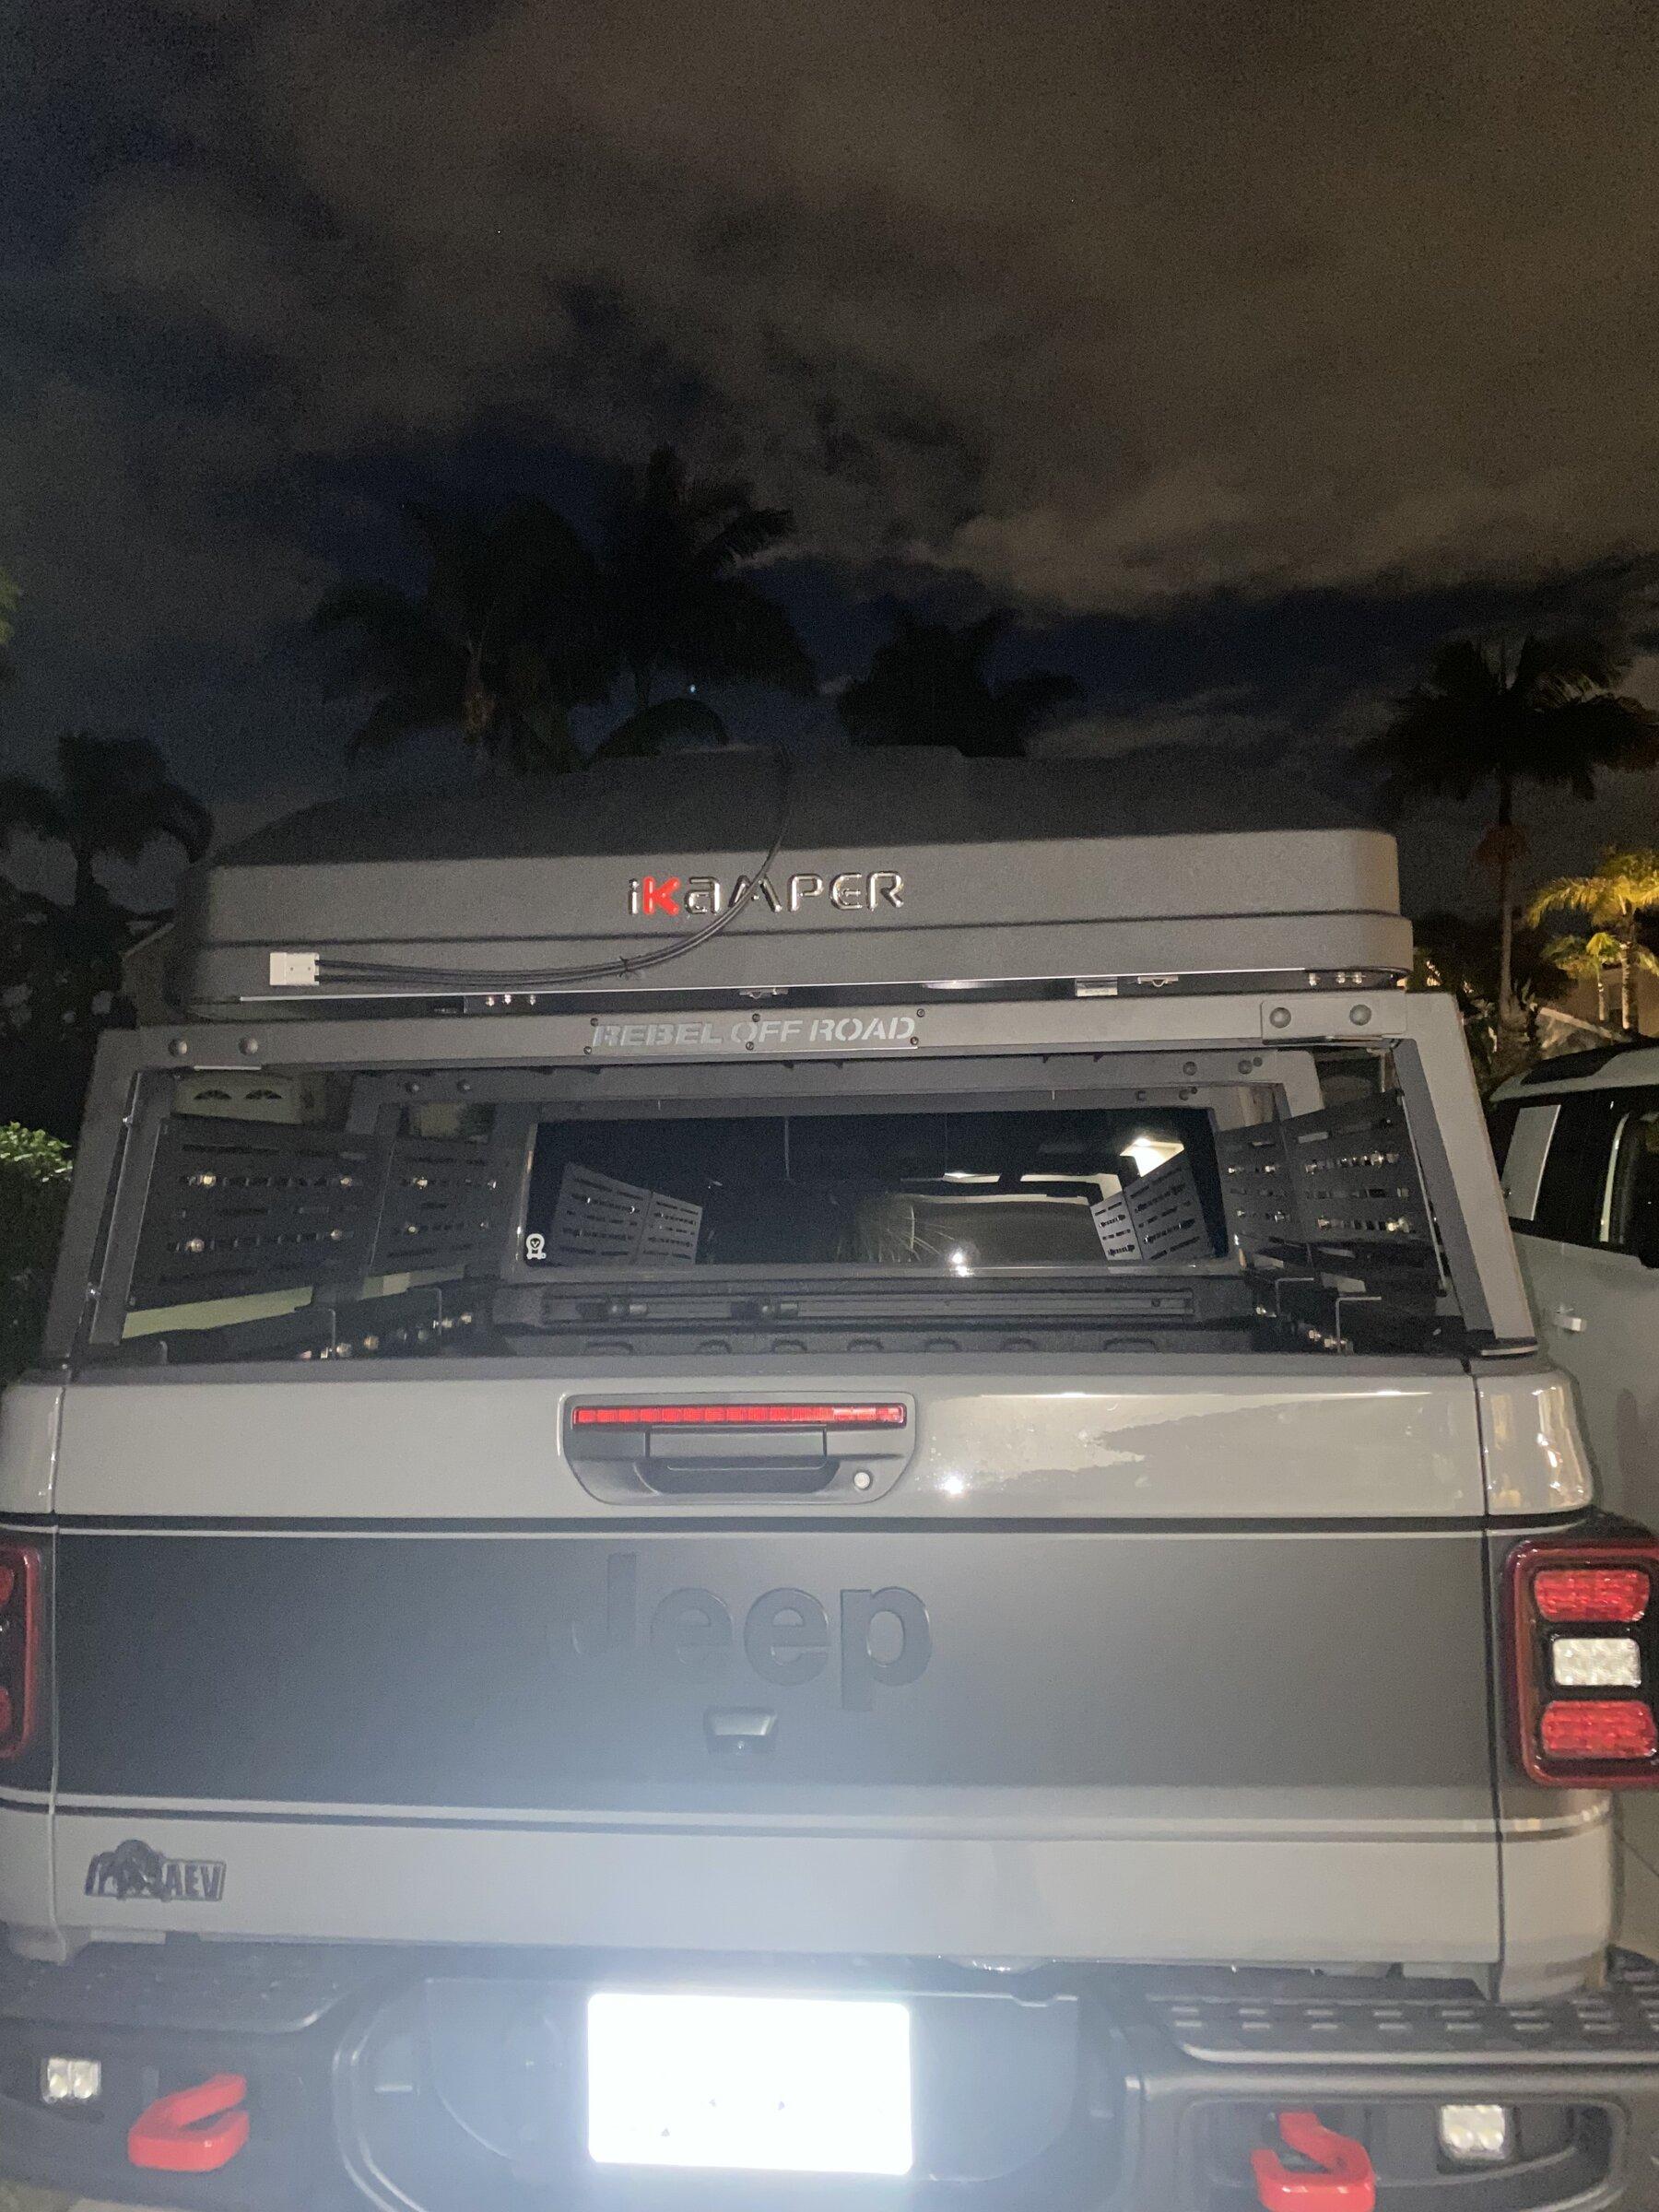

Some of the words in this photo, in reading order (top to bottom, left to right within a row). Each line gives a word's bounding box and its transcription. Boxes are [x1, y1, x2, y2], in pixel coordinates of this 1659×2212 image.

[593, 1022, 724, 1047] REBEL
[731, 1019, 804, 1043] OFF
[809, 1017, 915, 1041] ROAD
[547, 1552, 932, 1712] Jeep
[165, 1863, 221, 1900] AEV
